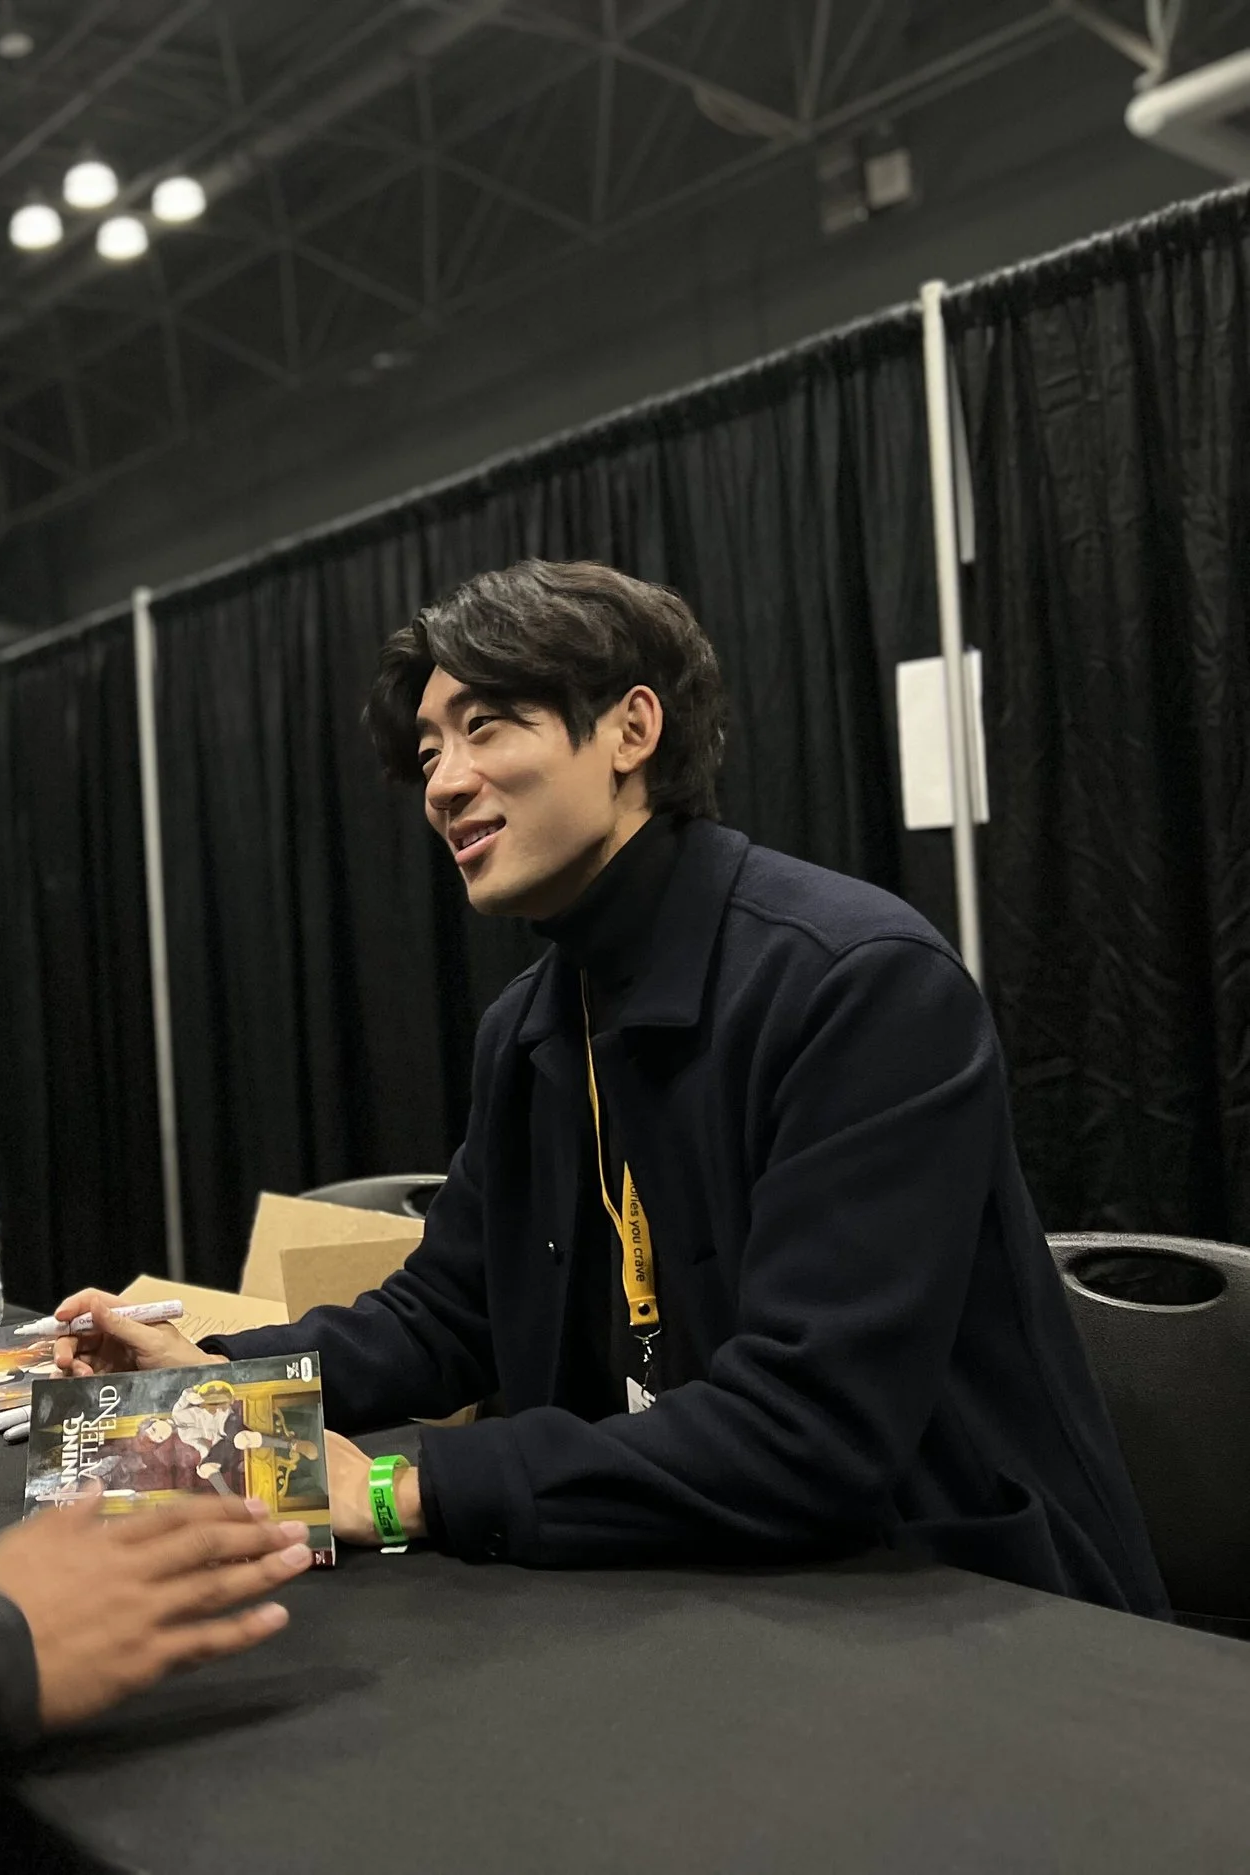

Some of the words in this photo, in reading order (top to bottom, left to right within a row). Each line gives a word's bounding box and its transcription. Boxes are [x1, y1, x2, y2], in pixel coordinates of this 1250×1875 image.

[630, 1221, 642, 1243] you
[634, 1249, 645, 1282] crave
[99, 1385, 120, 1430] END
[78, 1417, 102, 1480] AFTER
